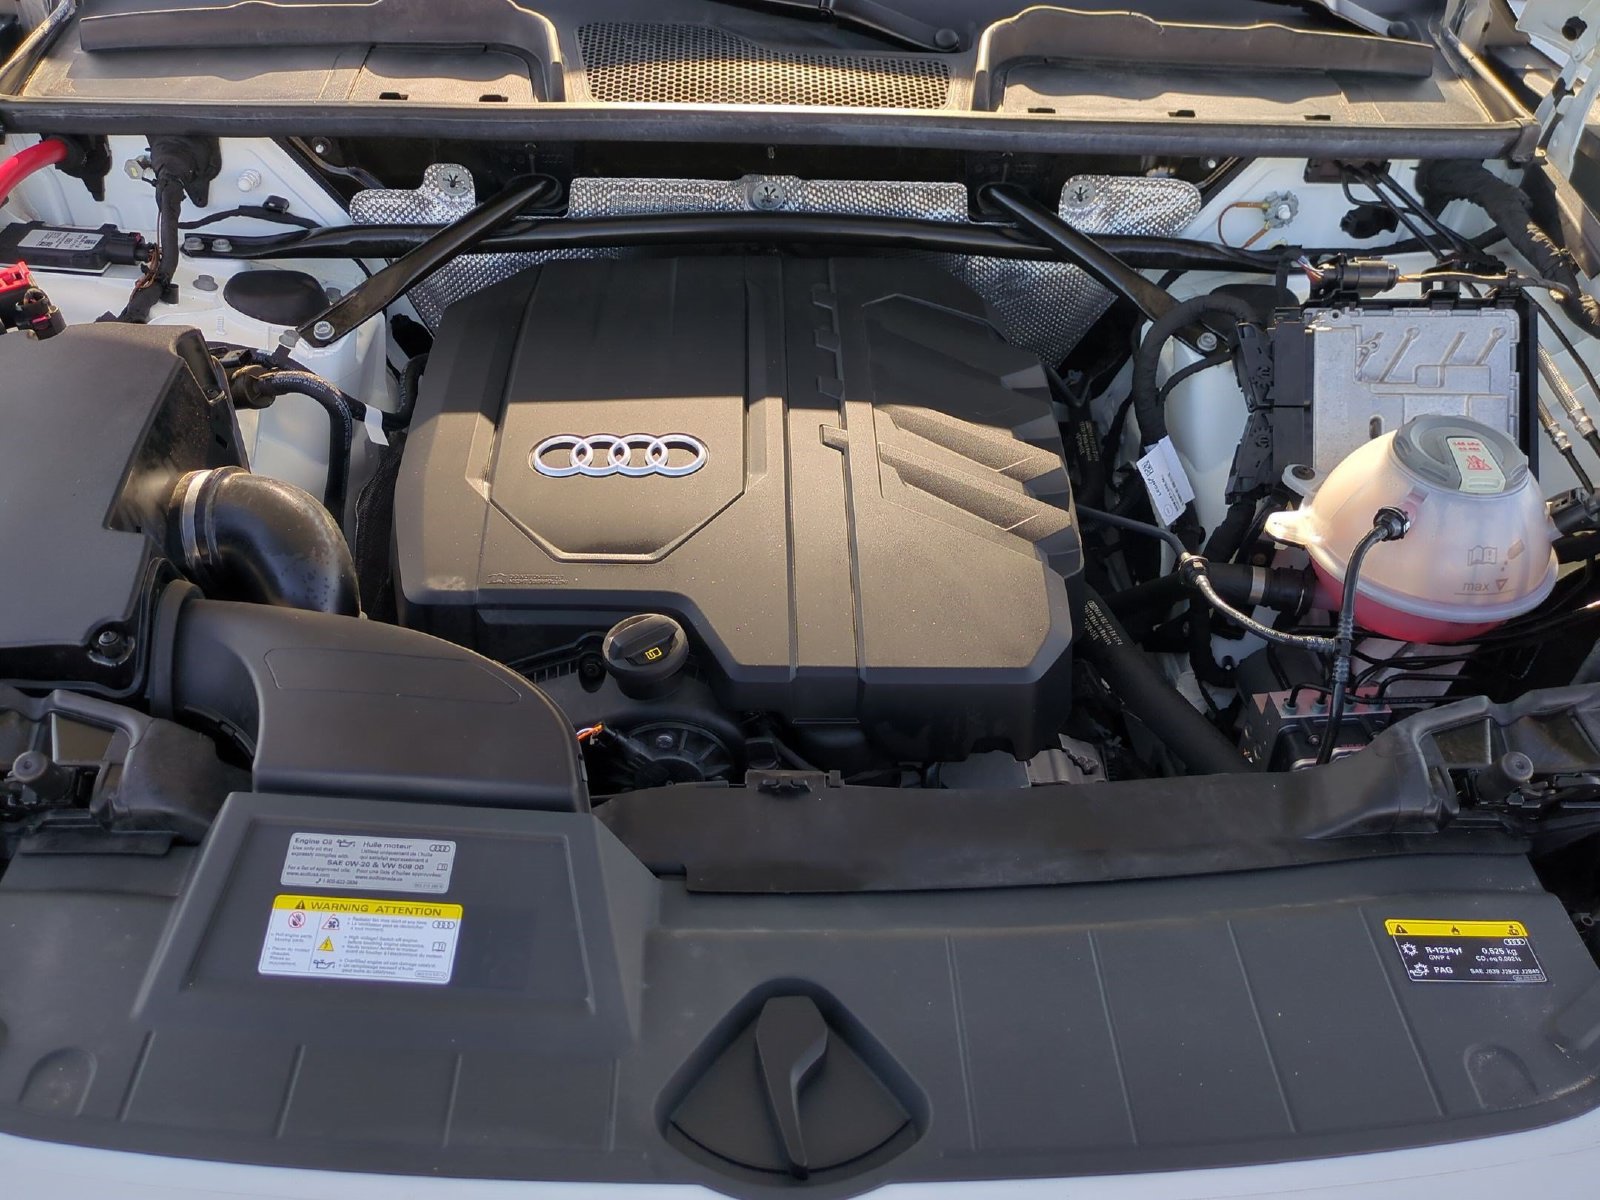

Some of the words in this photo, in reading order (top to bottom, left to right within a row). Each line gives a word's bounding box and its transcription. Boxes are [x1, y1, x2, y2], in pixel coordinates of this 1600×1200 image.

[1462, 581, 1489, 591] max
[294, 837, 320, 845] Engine
[311, 901, 369, 912] WARNING
[375, 904, 441, 916] ATTENTION
[1425, 945, 1463, 956] R-1234yf
[1507, 947, 1518, 957] kg
[1433, 966, 1453, 974] PAG
